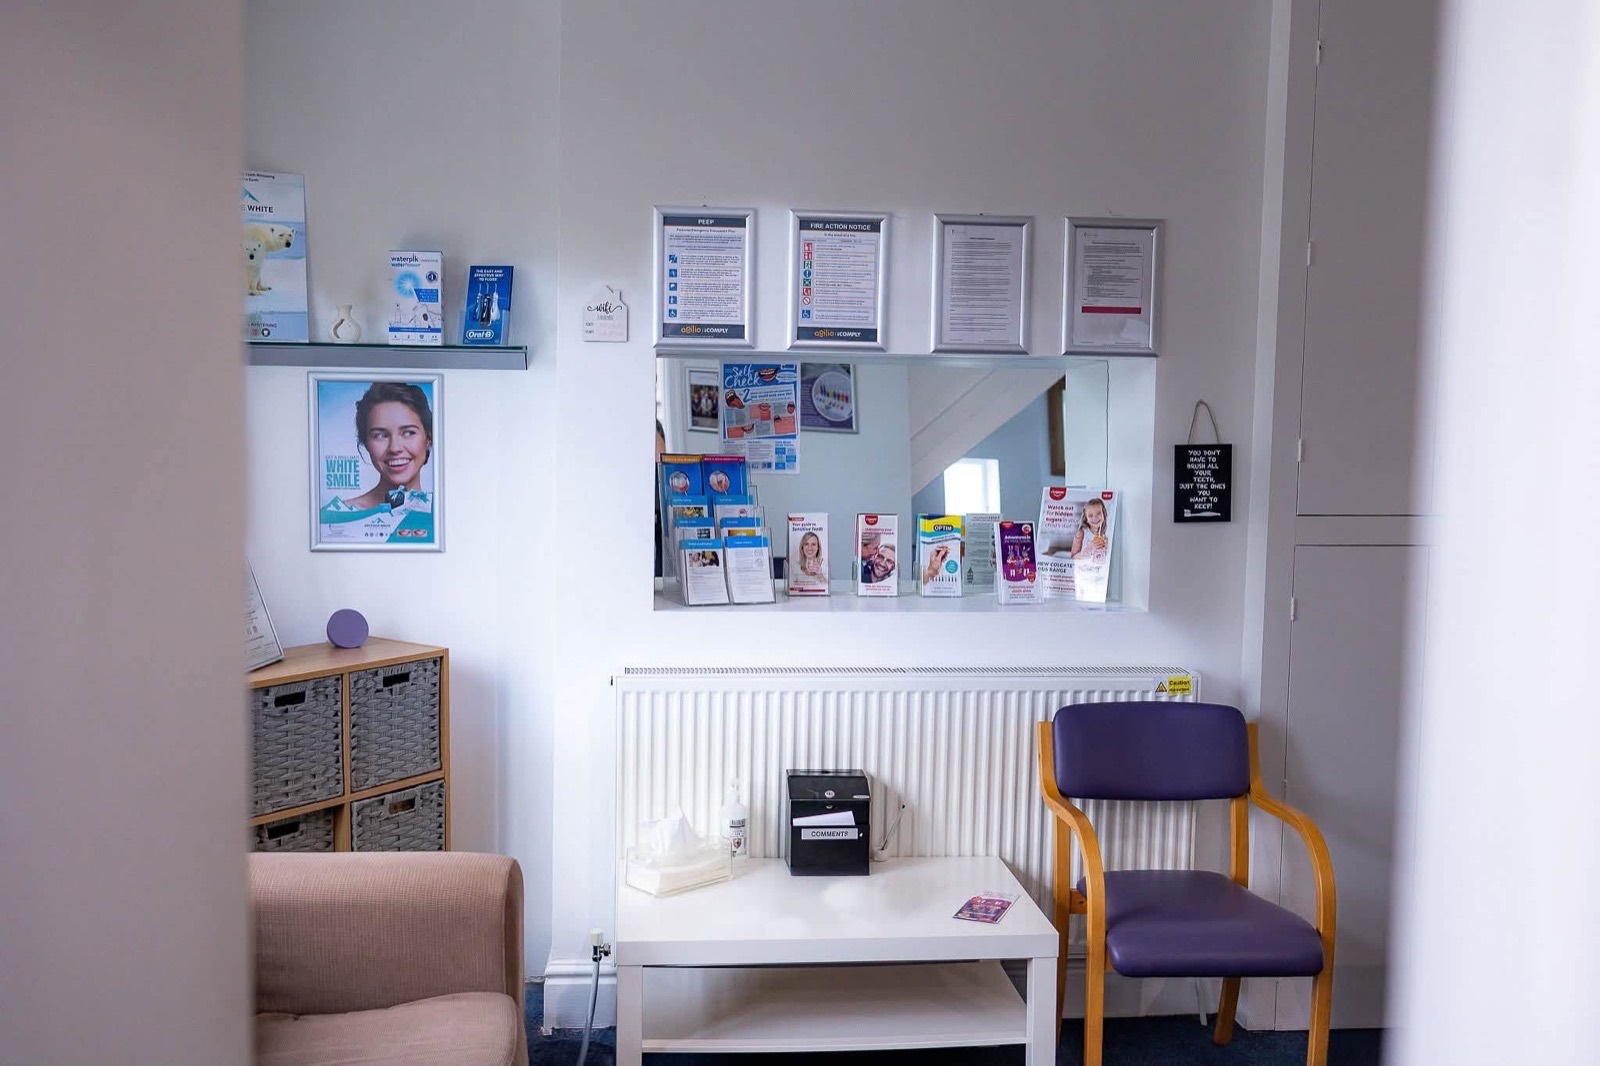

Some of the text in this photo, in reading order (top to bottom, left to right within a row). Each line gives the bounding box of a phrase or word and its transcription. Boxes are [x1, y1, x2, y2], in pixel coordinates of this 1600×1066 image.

[247, 204, 274, 213] WHITE
[391, 253, 419, 263] waterpik
[681, 325, 702, 335] agilio
[814, 328, 835, 338] agilio
[732, 364, 754, 378] Self
[725, 371, 761, 388] Check
[743, 388, 752, 402] 2
[326, 460, 360, 473] WHITE
[326, 473, 360, 487] SMILE
